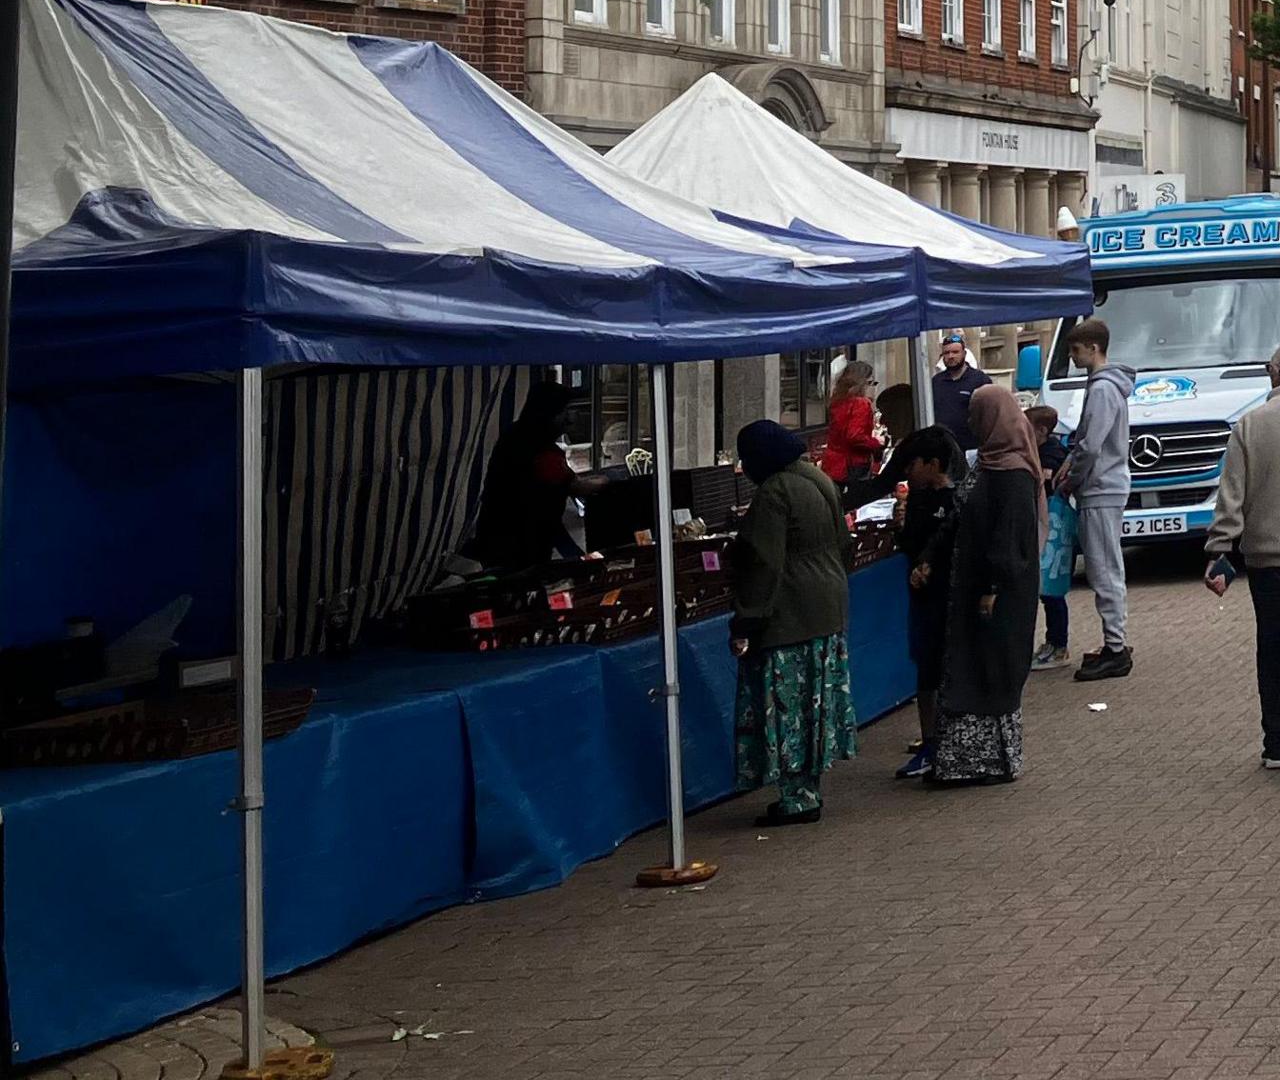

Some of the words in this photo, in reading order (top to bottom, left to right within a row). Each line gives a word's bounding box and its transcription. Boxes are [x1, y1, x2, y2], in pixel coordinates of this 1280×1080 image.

[982, 131, 1003, 149] FOUNTAIN
[1004, 133, 1020, 151] HOUSE
[1091, 228, 1145, 252] ICE
[1155, 220, 1280, 247] CREAM
[1136, 521, 1145, 533] 2
[1150, 518, 1182, 533] ICES
